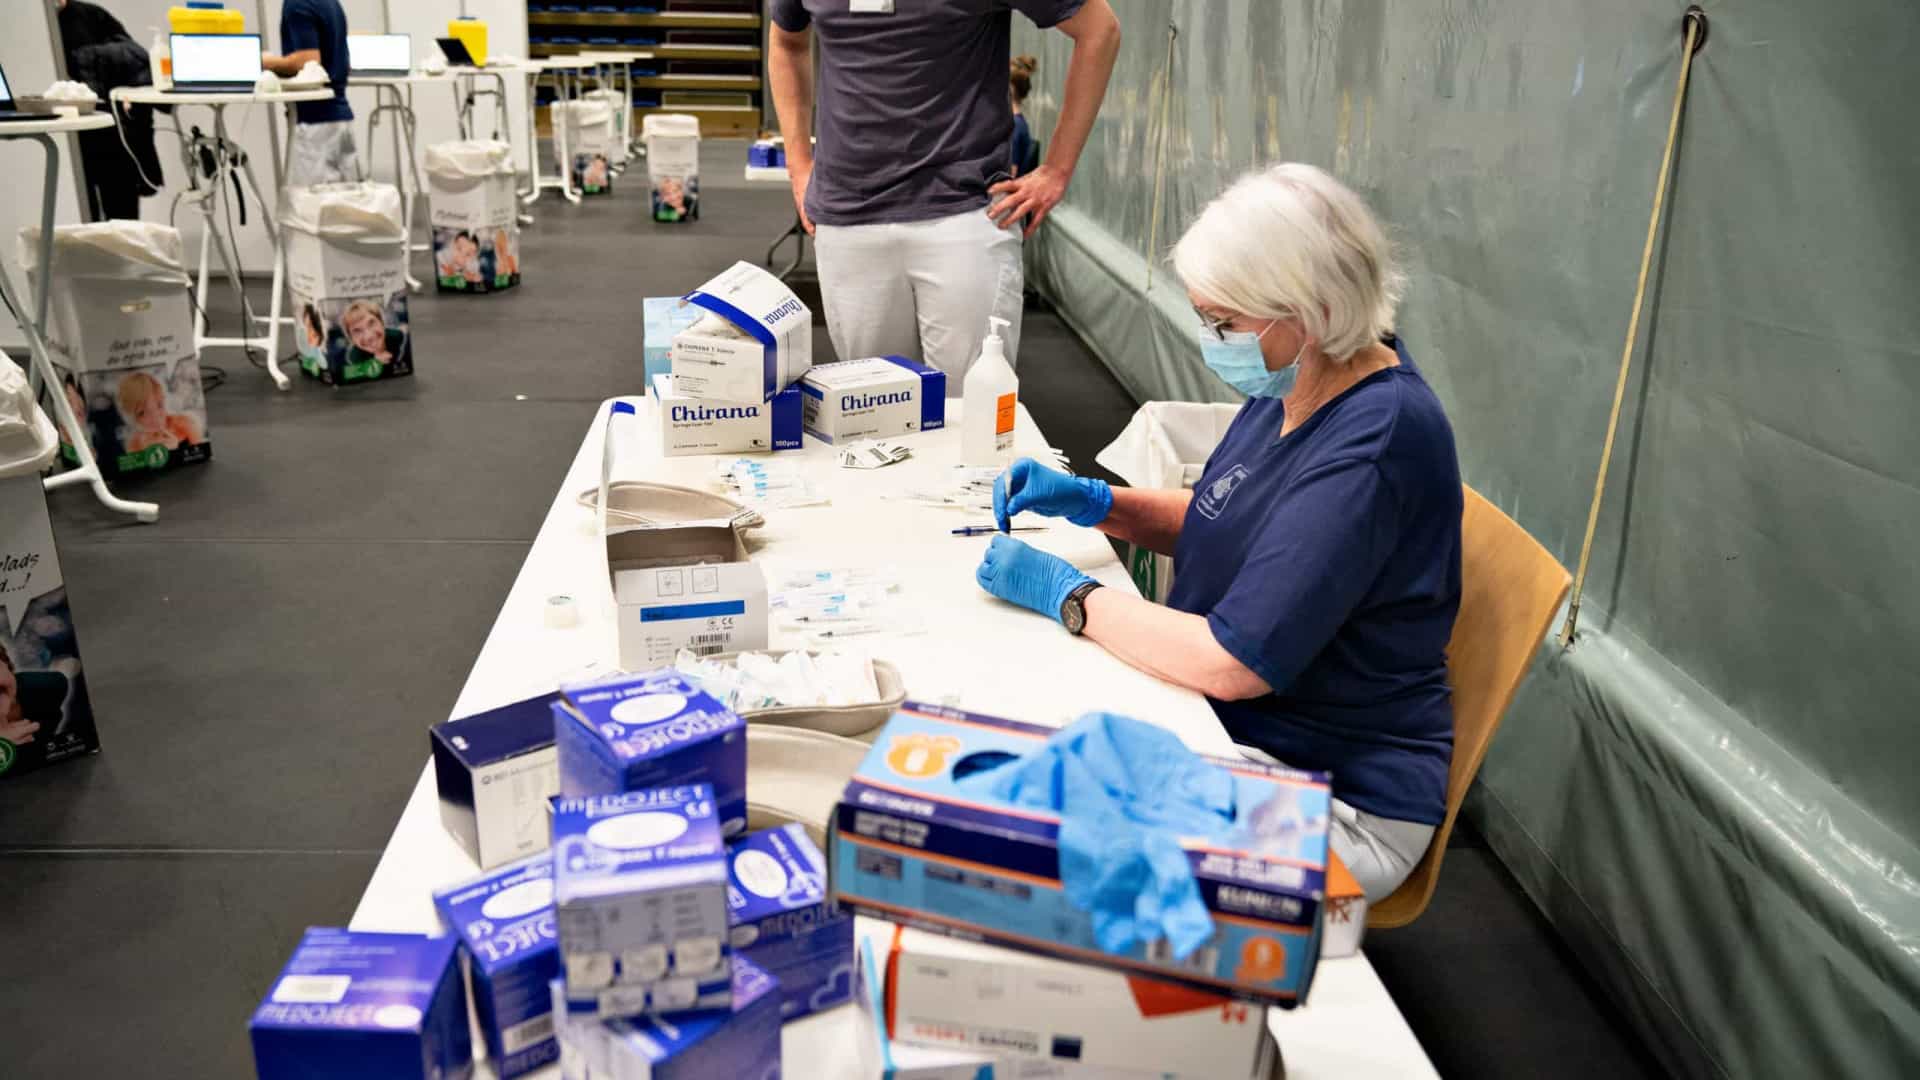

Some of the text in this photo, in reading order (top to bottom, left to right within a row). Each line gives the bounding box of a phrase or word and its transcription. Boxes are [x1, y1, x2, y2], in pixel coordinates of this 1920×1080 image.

[764, 299, 802, 324] Chirana
[841, 390, 912, 411] Chirana
[671, 404, 760, 421] Chirana
[0, 552, 40, 572] lads
